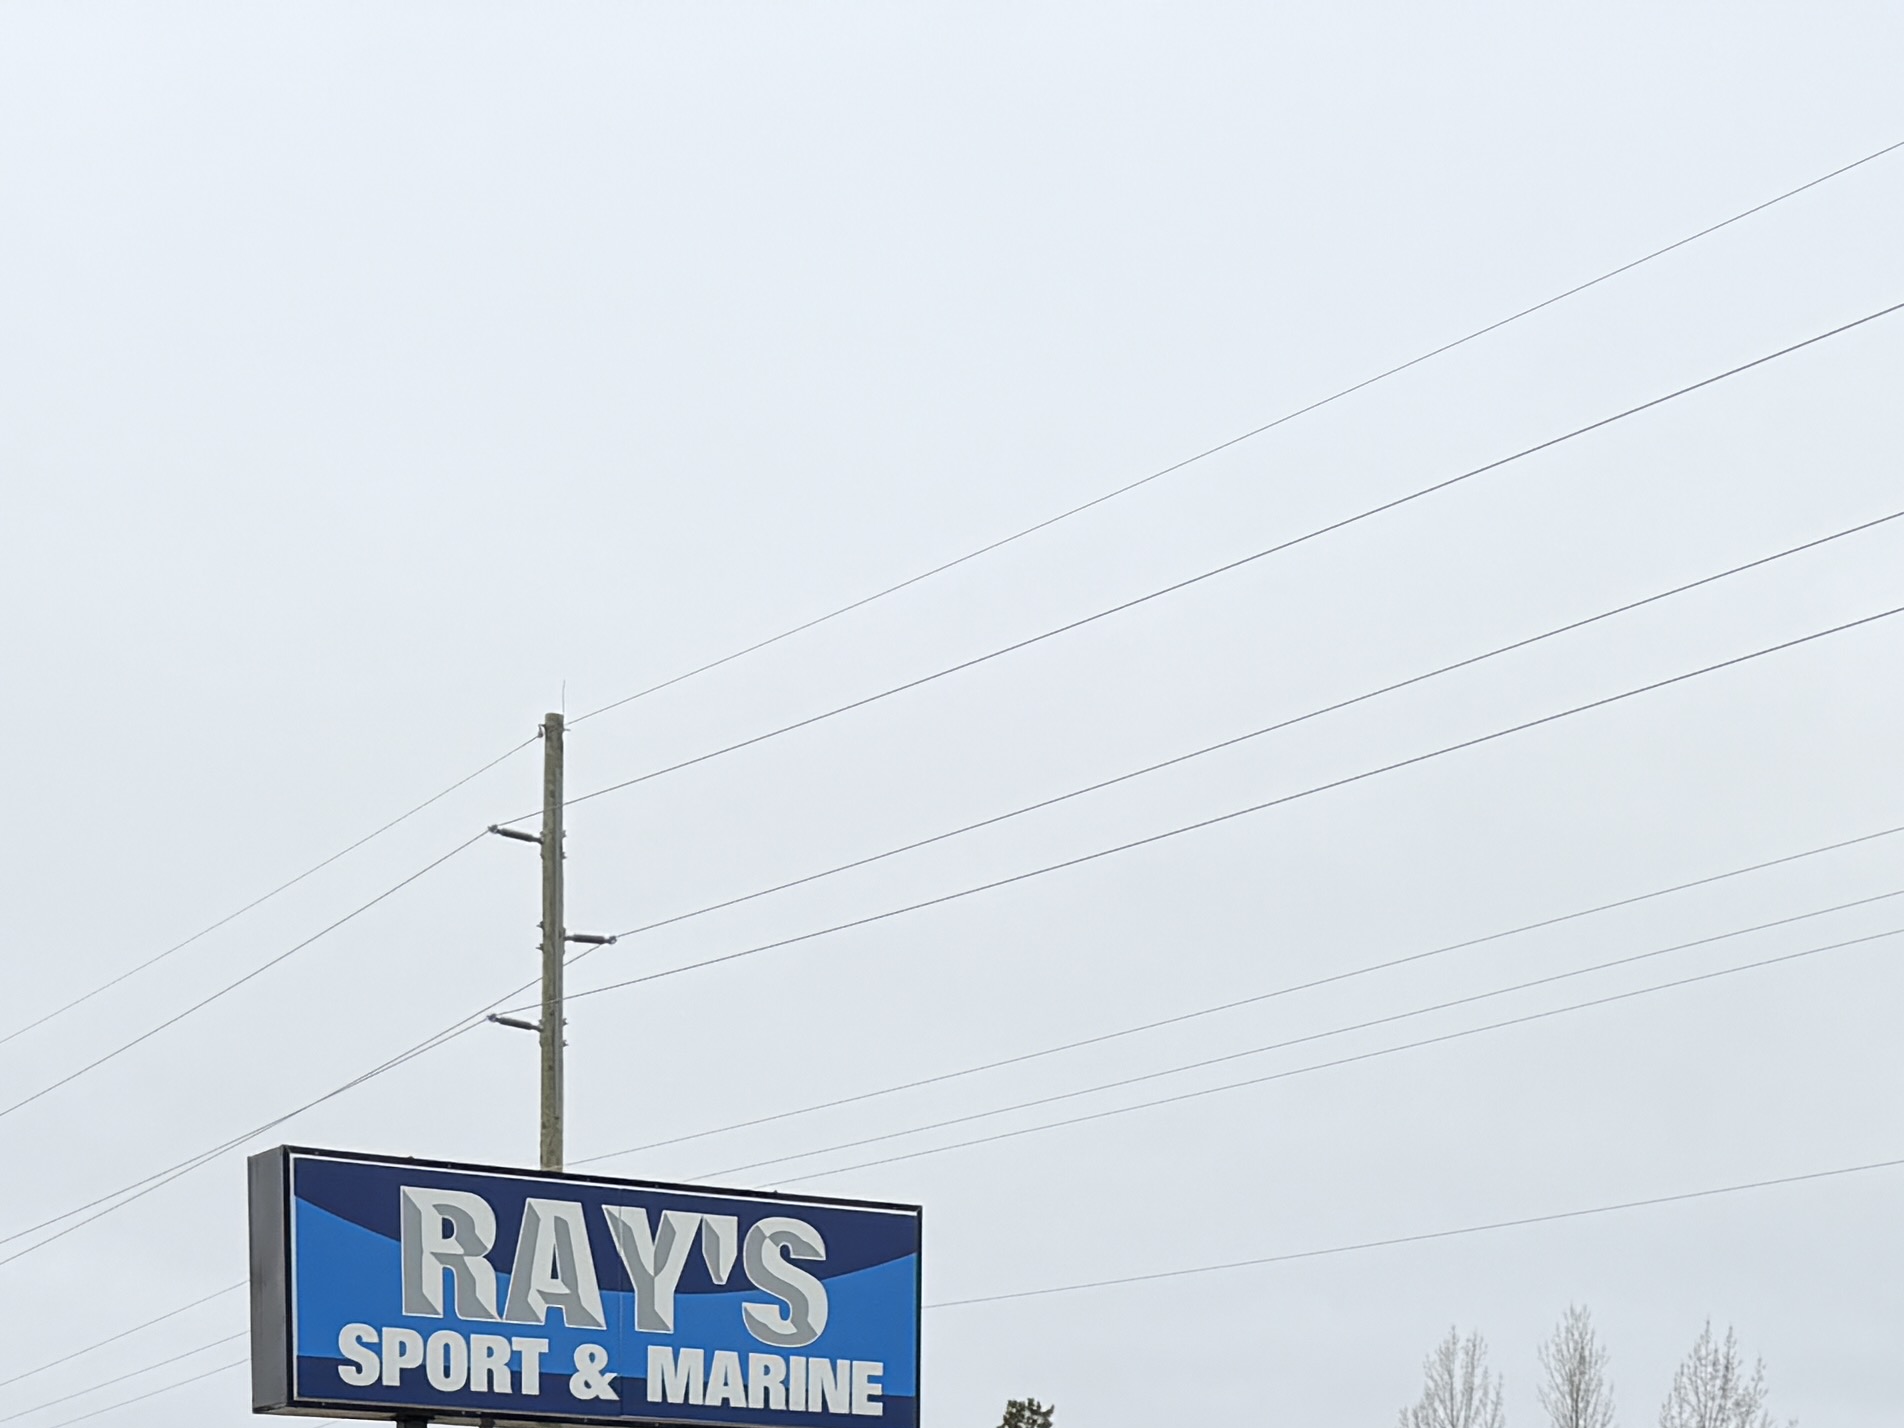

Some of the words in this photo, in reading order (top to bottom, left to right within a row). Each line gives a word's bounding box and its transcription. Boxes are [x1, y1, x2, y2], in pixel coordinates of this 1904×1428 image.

[399, 1185, 830, 1348] RAY'S
[337, 1322, 550, 1396] SPORT
[569, 1341, 620, 1402] &
[646, 1345, 884, 1416] MARINE
